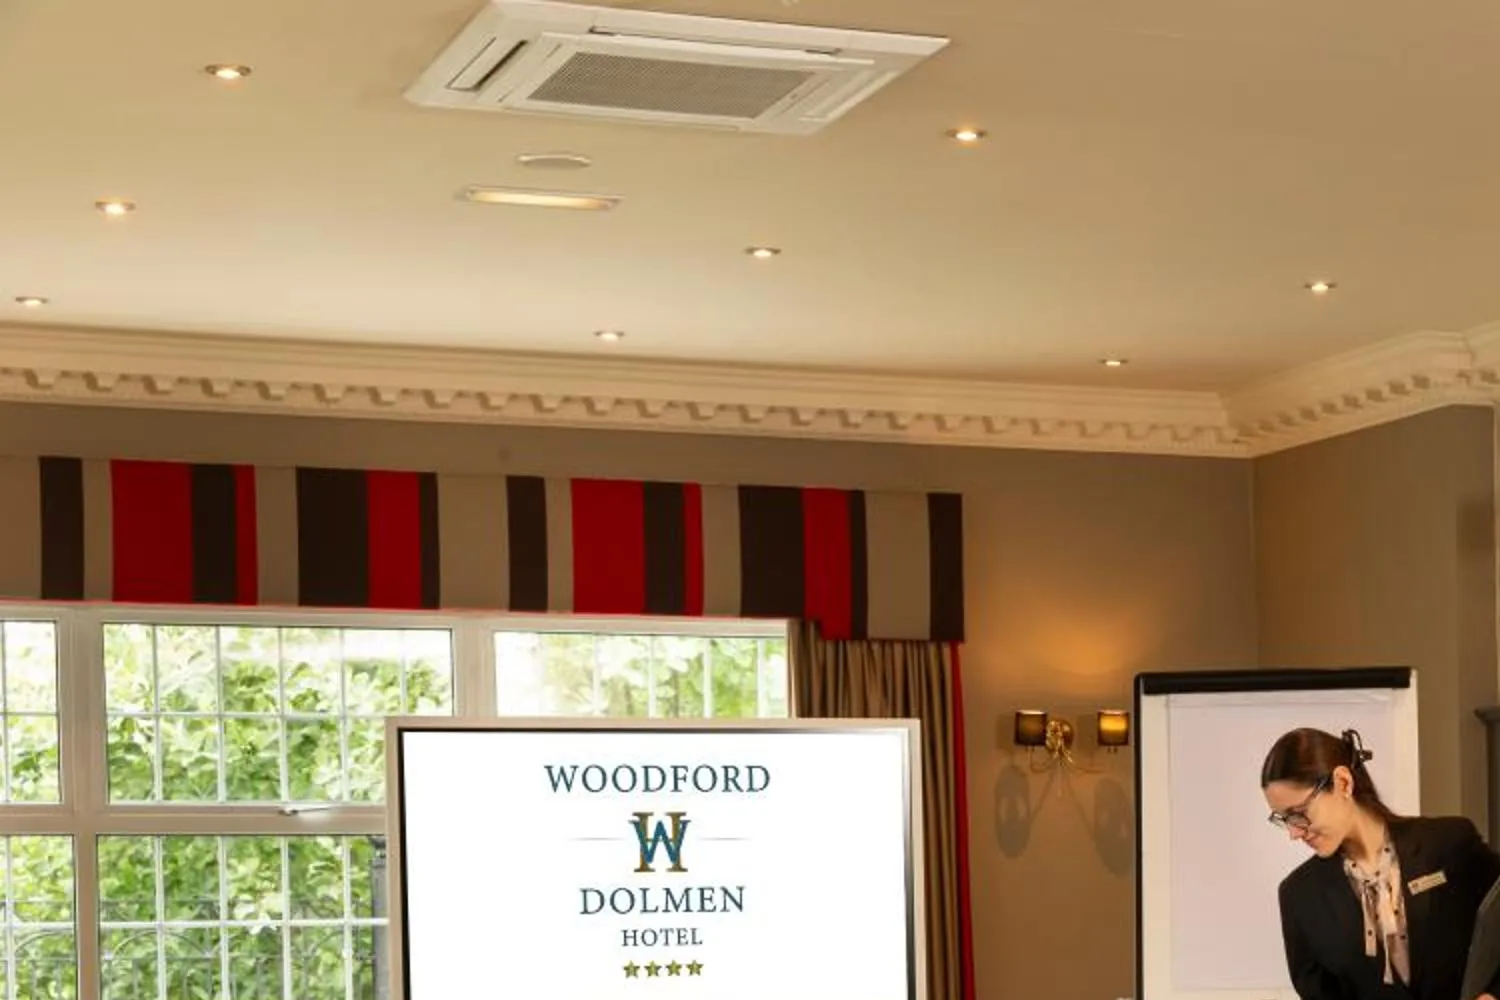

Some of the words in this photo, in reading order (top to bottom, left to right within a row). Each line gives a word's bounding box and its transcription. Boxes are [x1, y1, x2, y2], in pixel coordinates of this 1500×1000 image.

[543, 764, 771, 793] WOODFORD
[579, 886, 746, 915] DOLMEN
[621, 927, 704, 947] HOTEL
